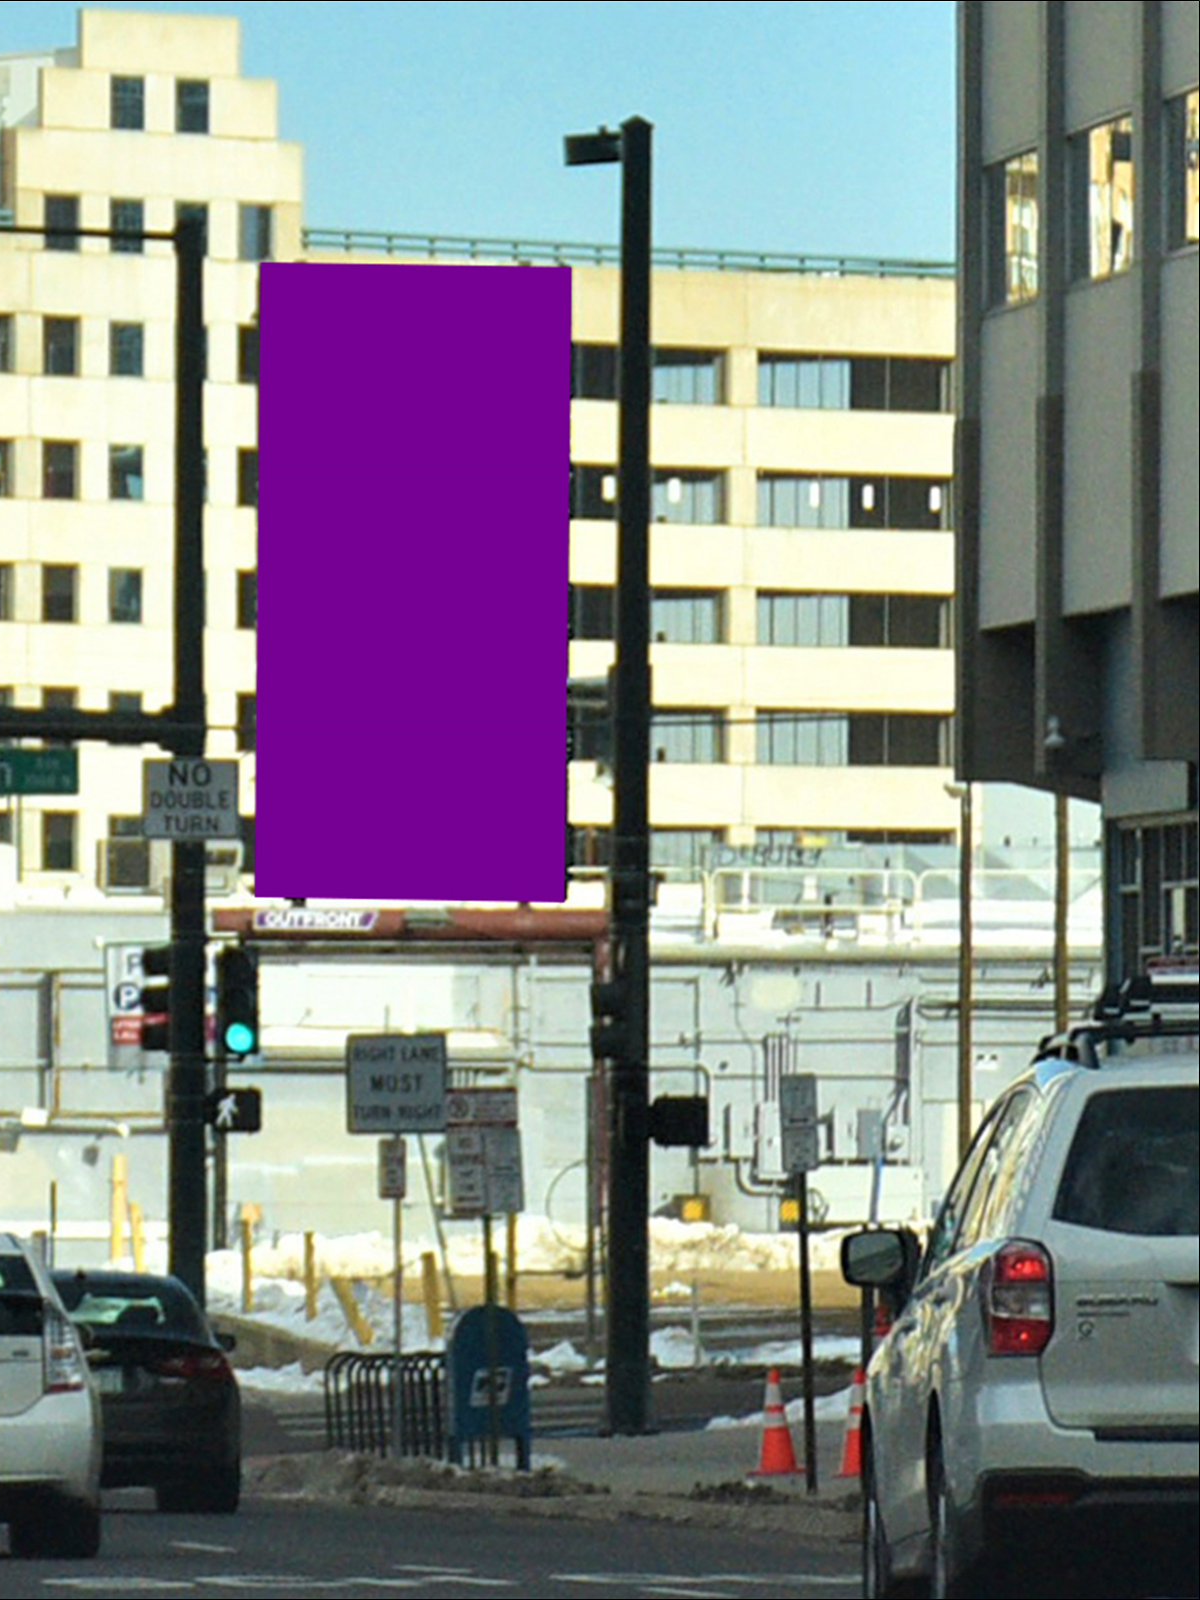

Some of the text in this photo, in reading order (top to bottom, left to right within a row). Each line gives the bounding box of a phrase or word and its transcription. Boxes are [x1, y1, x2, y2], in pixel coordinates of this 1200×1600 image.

[169, 763, 212, 786] NO
[150, 790, 229, 809] DOUBLE
[164, 814, 219, 834] TURN
[354, 1045, 439, 1062] RIGHT LANE
[370, 1074, 423, 1092] MUST
[353, 1103, 392, 1119] TURN
[397, 1103, 442, 1120] RIGHT
